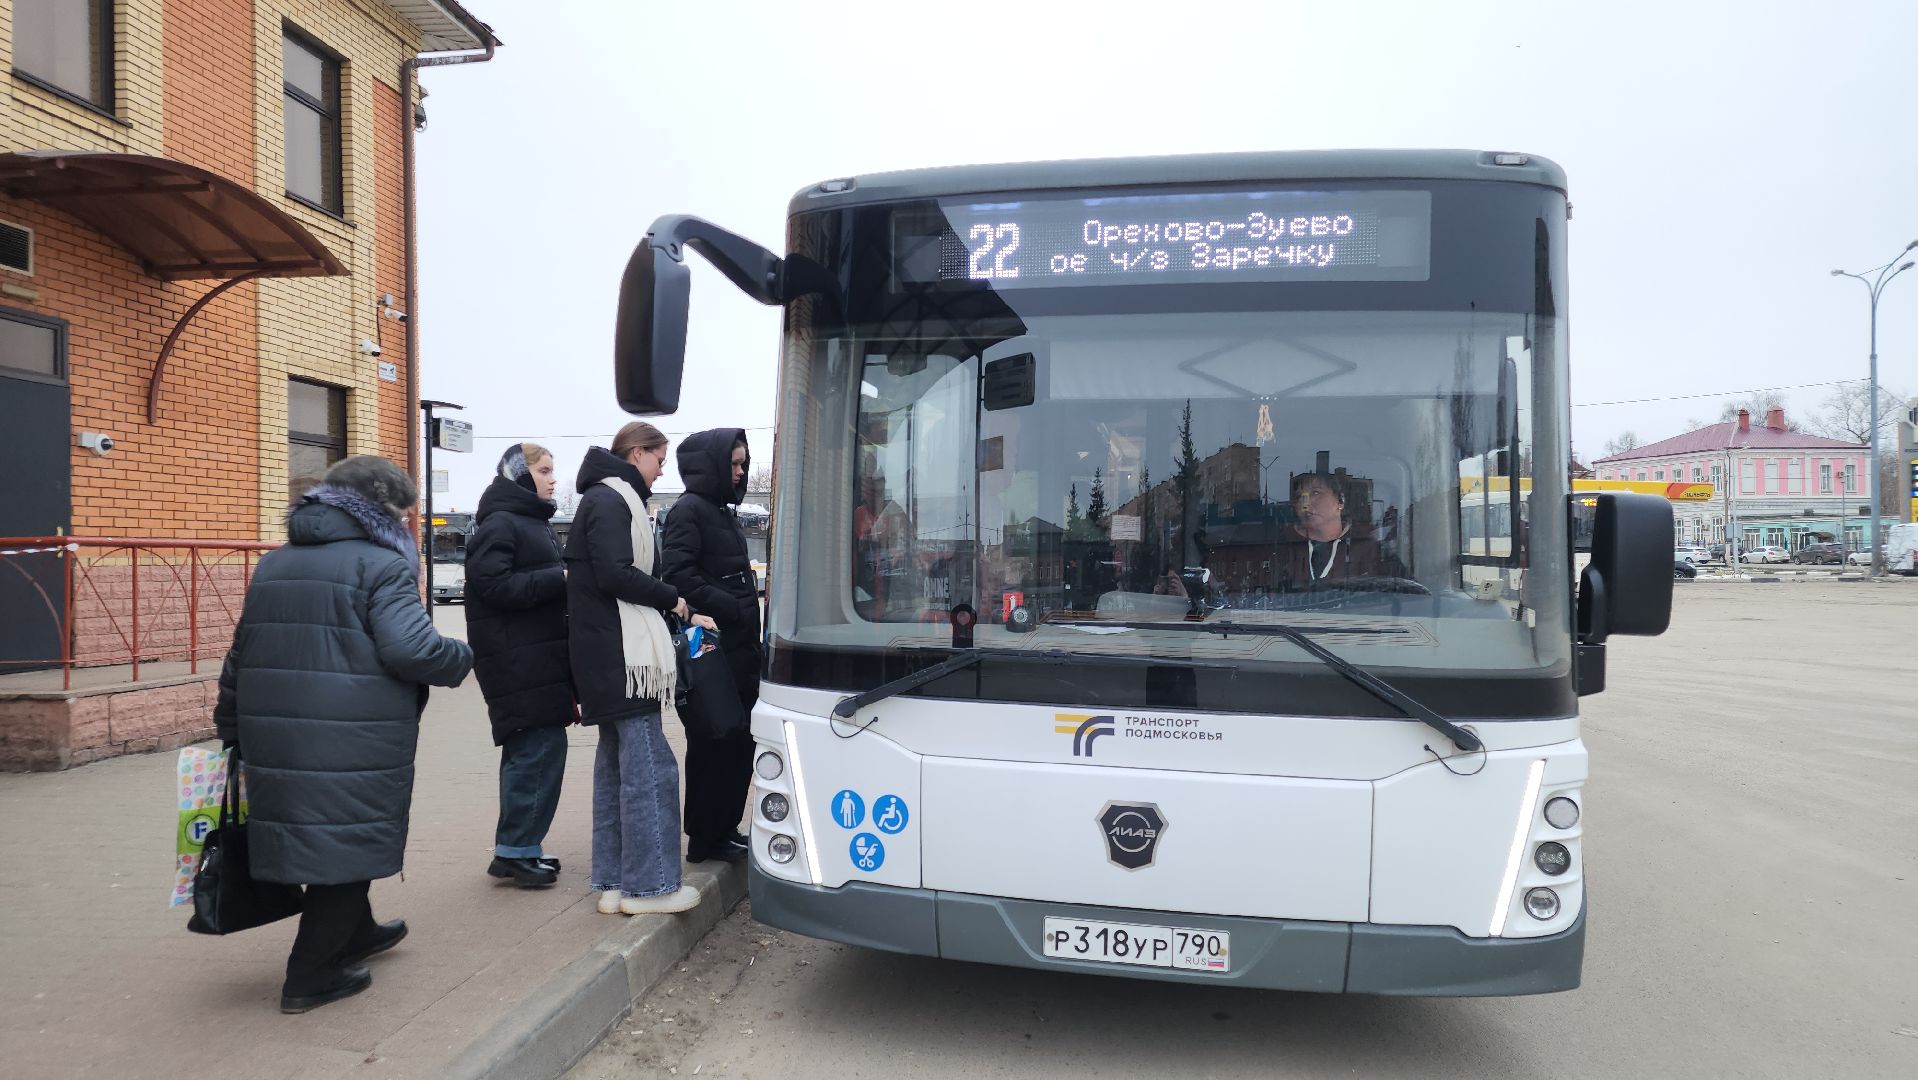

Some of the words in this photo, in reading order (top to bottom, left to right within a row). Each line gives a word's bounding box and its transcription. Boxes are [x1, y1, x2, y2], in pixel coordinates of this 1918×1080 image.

[1084, 211, 1353, 248] Орехово-Зуево
[969, 222, 1020, 280] 22
[1191, 241, 1335, 270] Заречку
[1125, 716, 1200, 727] ТРАНСПОРТ
[1125, 728, 1223, 741] ПОДМОСКОВЬЯ
[194, 821, 207, 839] F
[1108, 826, 1156, 838] ЛИАЗ
[1054, 925, 1168, 960] Р318УР
[1175, 932, 1221, 957] 790
[1185, 956, 1207, 966] RUS
